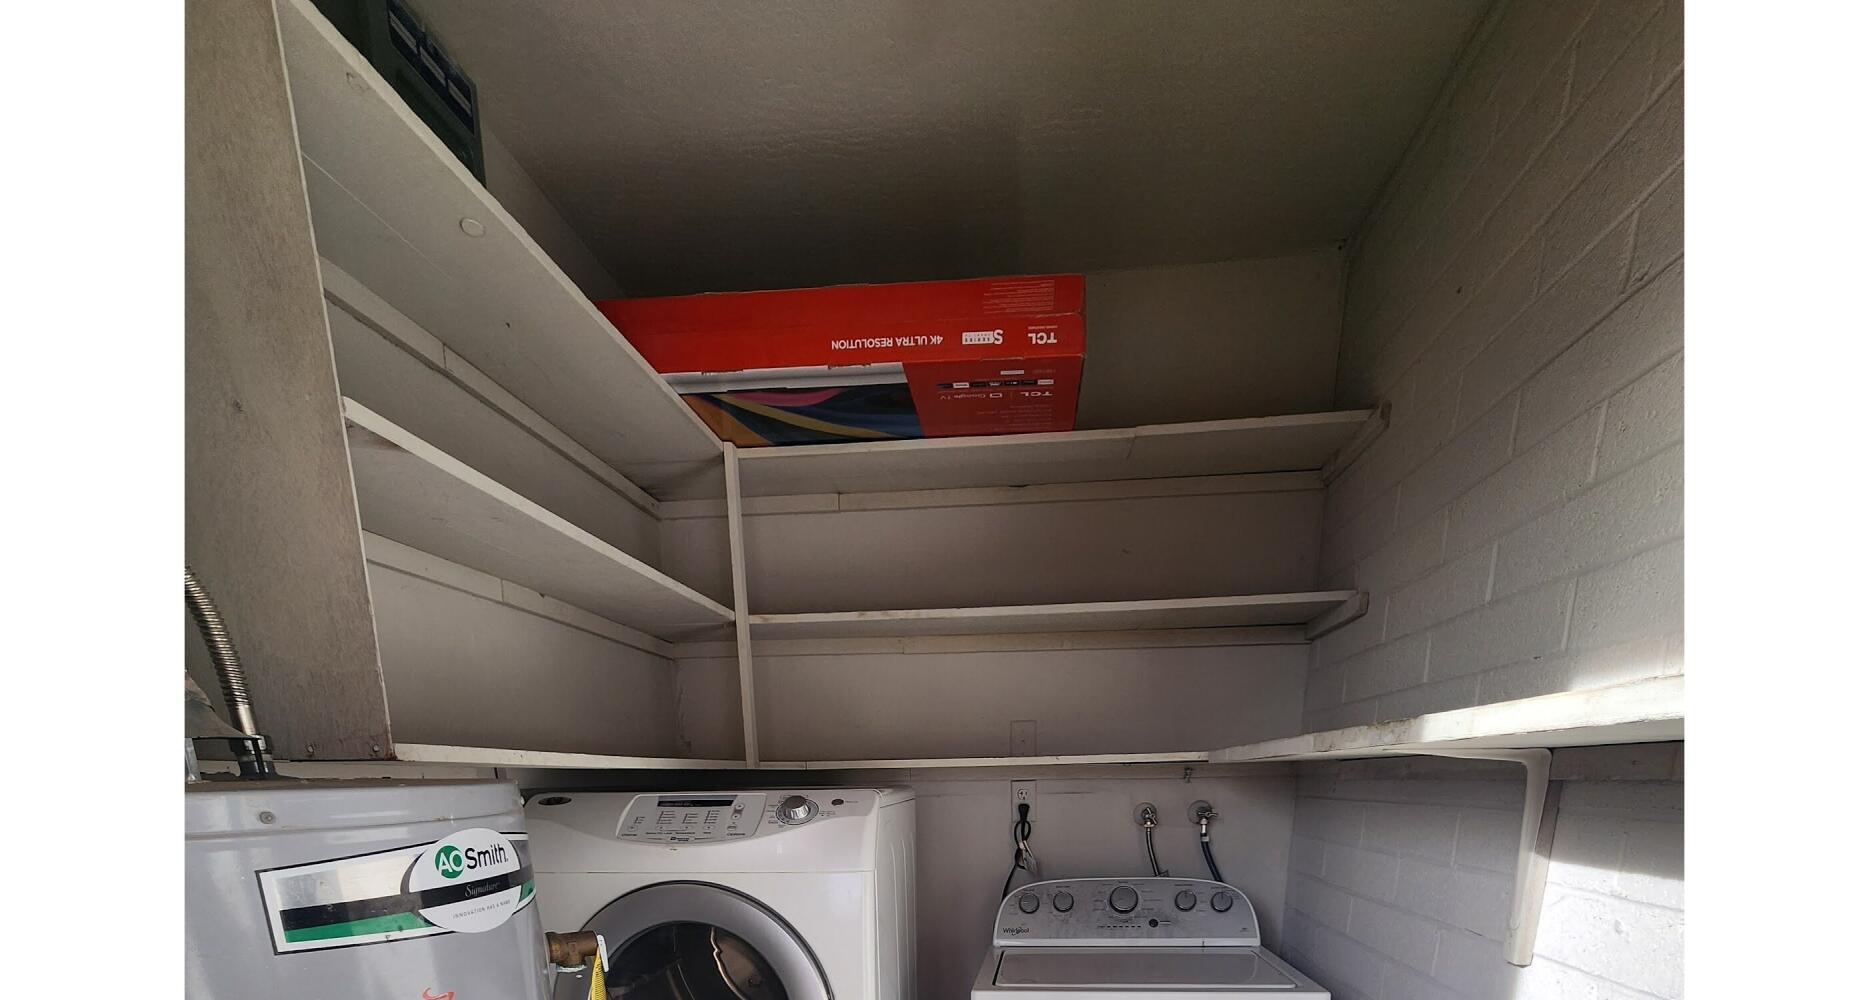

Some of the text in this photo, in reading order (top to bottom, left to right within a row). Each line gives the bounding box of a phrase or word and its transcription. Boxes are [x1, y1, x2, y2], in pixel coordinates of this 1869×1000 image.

[831, 335, 943, 350] 4K ULTRA RESOLUTION
[1027, 332, 1058, 344] TCL
[464, 844, 507, 869] Smith
[464, 882, 499, 897] Signature
[453, 907, 485, 919] INNOVATION
[1002, 926, 1030, 936] Whirlpool
